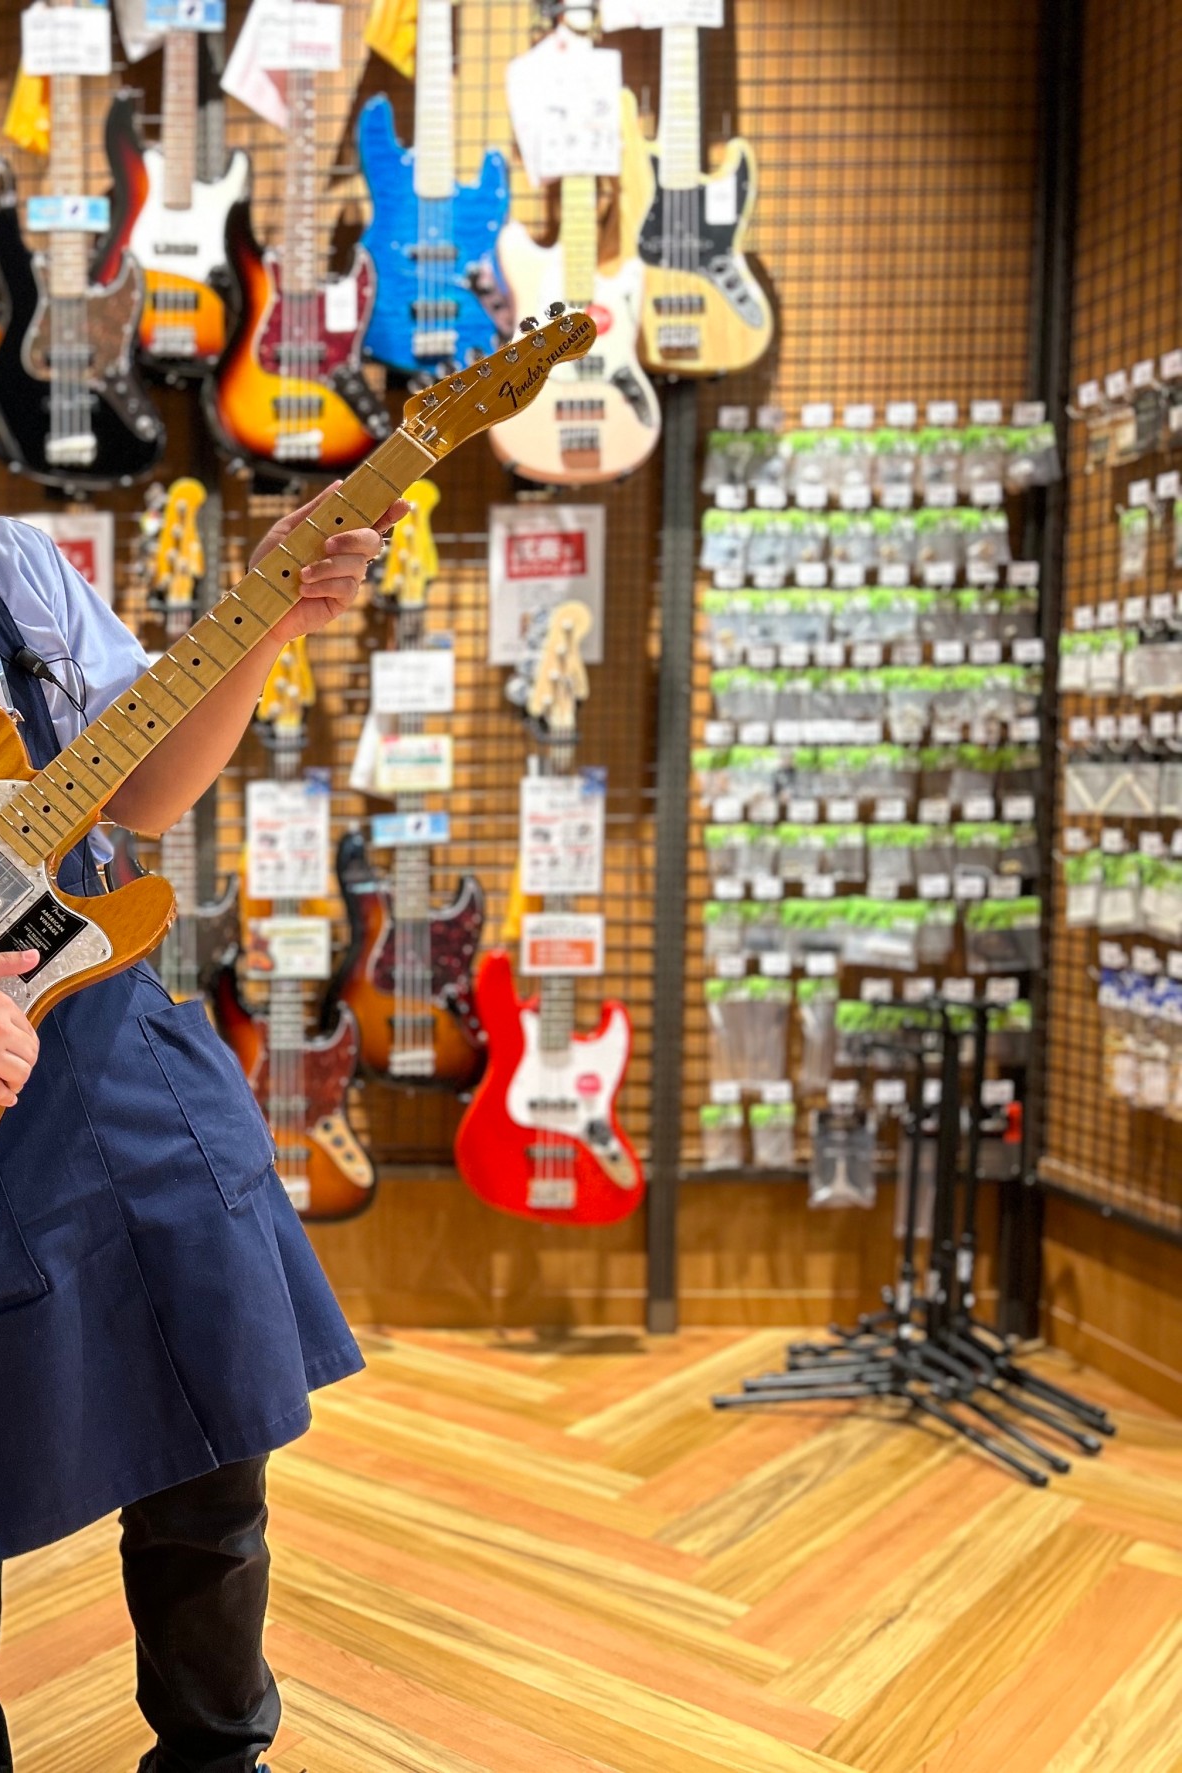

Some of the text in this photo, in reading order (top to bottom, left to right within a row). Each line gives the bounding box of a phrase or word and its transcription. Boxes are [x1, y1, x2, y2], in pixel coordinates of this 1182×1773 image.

[499, 321, 590, 408] Fender TELECASTER
[39, 916, 59, 936] VINTAGE
[41, 909, 65, 933] AMERICAN
